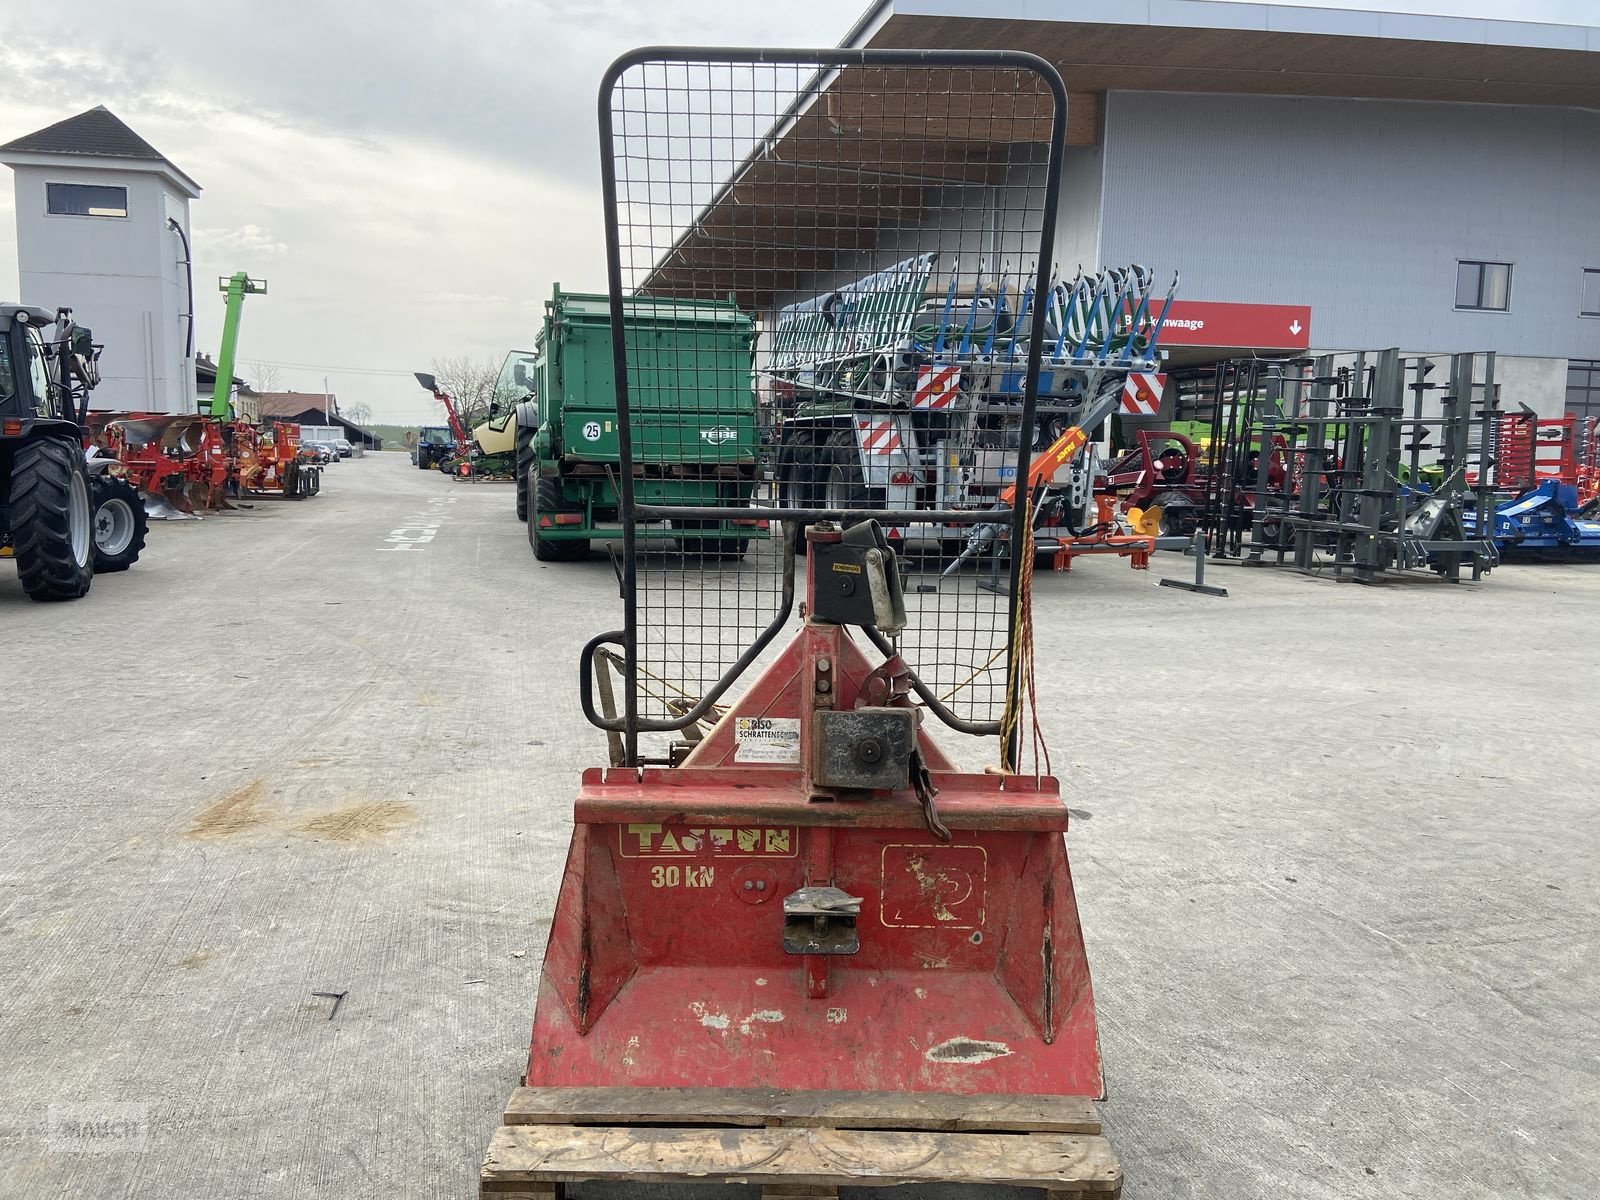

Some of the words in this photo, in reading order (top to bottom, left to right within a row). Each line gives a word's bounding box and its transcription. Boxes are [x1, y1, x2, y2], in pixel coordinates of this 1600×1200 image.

[586, 425, 599, 438] 25
[751, 719, 772, 730] BISO
[651, 866, 680, 888] 30
[685, 866, 714, 888] kN
